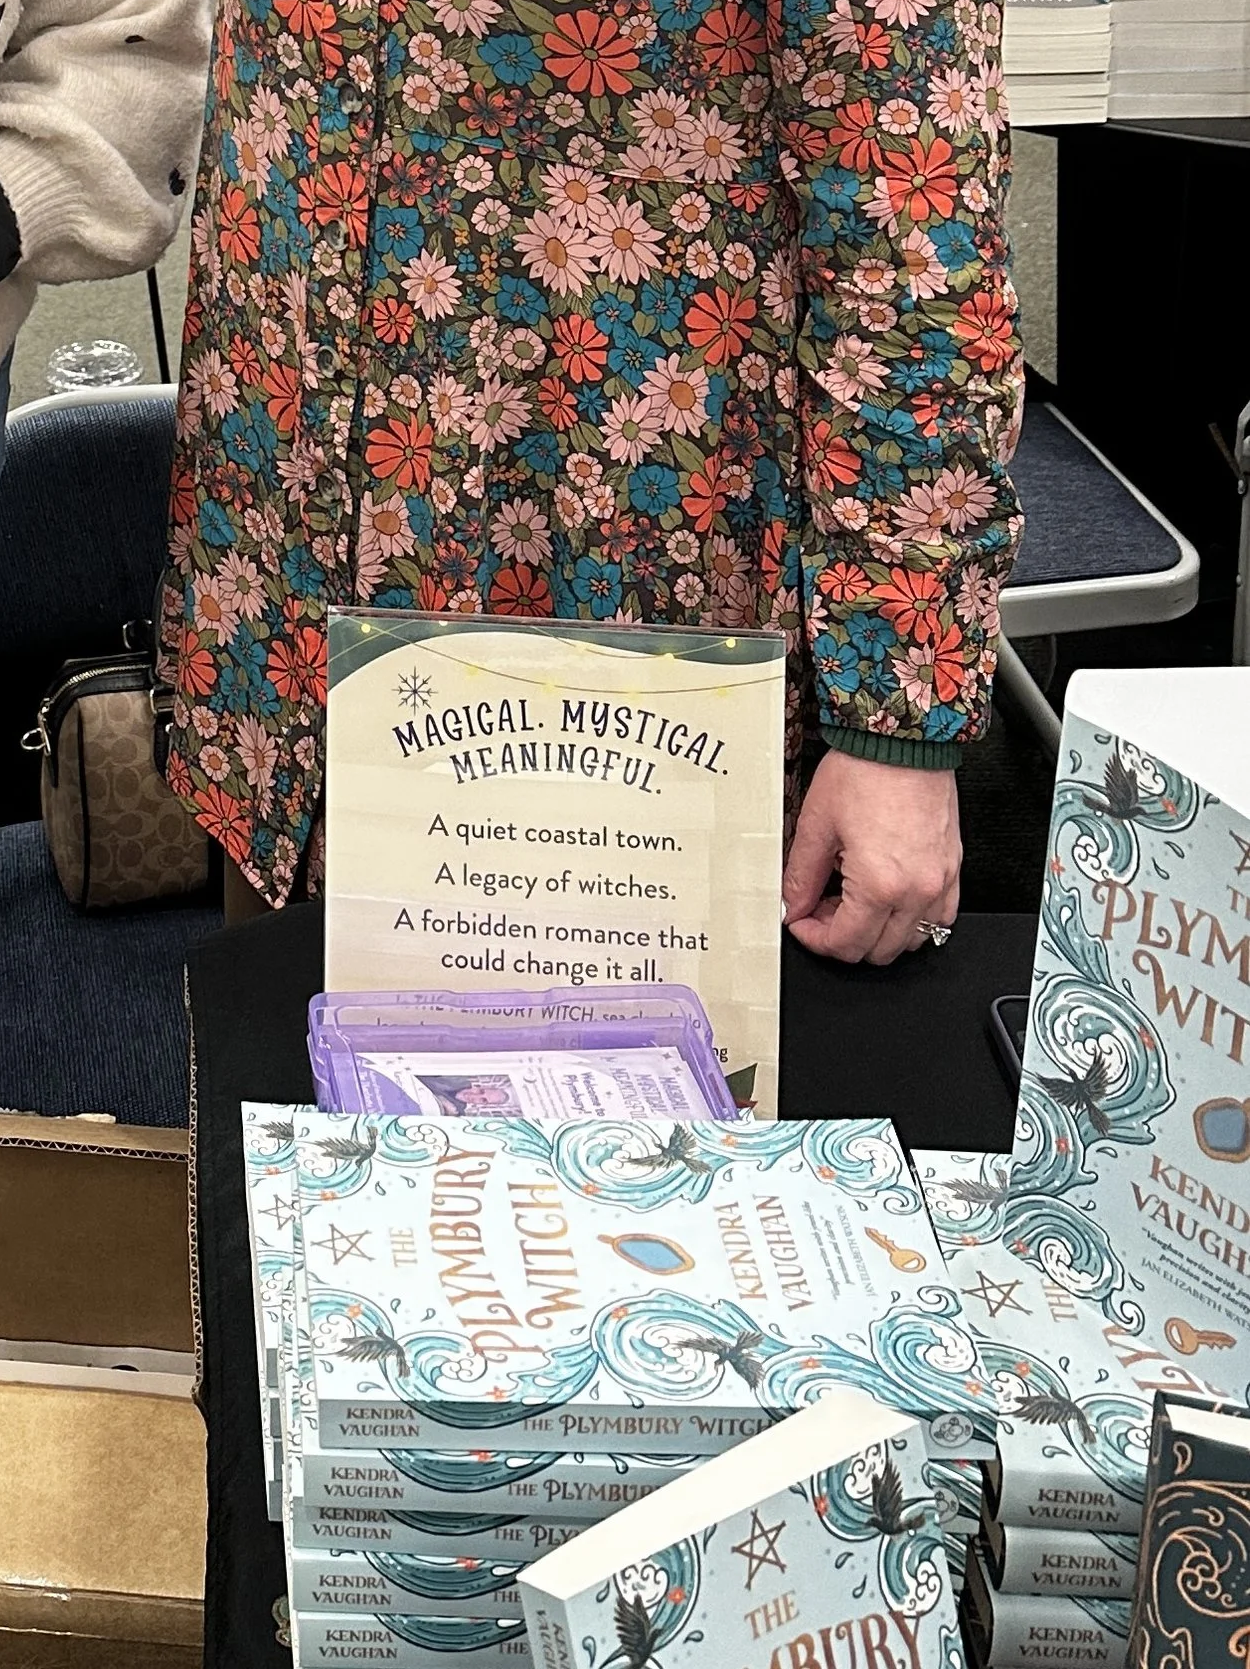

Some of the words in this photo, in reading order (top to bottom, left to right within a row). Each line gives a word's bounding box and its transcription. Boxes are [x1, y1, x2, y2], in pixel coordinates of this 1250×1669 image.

[391, 698, 545, 759] MAGICAL.
[560, 699, 730, 777] MYSTICAL.
[449, 741, 663, 795] MEANINGFUL.
[427, 814, 450, 837] A
[455, 819, 517, 847] quiet
[524, 825, 608, 848] coastal
[615, 829, 683, 853] town.
[434, 862, 456, 886] A
[463, 864, 539, 899] legacy
[545, 870, 572, 893] of
[578, 874, 677, 901] witches.
[393, 908, 415, 932] A
[421, 910, 537, 940] forbidden
[545, 924, 651, 947] romance
[657, 928, 710, 952] that
[440, 950, 505, 974] could
[513, 954, 599, 986] change
[605, 958, 623, 982] it
[629, 960, 664, 983] all.
[581, 1070, 600, 1106] Welcome
[835, 1204, 853, 1237] WATSON
[1130, 1180, 1250, 1279] VAUGH
[387, 1226, 419, 1269] THE
[429, 1145, 544, 1365] PLYMBURY
[507, 1180, 587, 1333] WITCH
[713, 1201, 768, 1302] KENDRA
[753, 1193, 816, 1313] VAUGHAN
[846, 1238, 871, 1281] ELIZABETH
[1141, 1256, 1162, 1277] JAN
[1162, 1270, 1223, 1313] ELIZABETH
[1159, 1253, 1201, 1283] precision
[1200, 1279, 1222, 1295] and
[1185, 1256, 1214, 1278] writes
[1215, 1272, 1237, 1292] with
[863, 1282, 877, 1297] JAN
[345, 1406, 415, 1421] KENDRA
[339, 1422, 420, 1438] VAUGHAN
[522, 1417, 554, 1432] THE
[559, 1413, 685, 1437] PLYMBURY
[330, 1465, 400, 1483] KENDRA
[323, 1483, 405, 1500] VAUGHAN
[507, 1482, 539, 1498] THE
[1037, 1487, 1117, 1508] KENDRA
[318, 1507, 387, 1523] KENDRA
[1027, 1505, 1121, 1524] VAUGHAN
[312, 1524, 393, 1541] VAUGHAN
[493, 1527, 525, 1543] THE
[1041, 1552, 1119, 1572] KENDRA
[318, 1573, 388, 1590] KENDRA
[1030, 1571, 1123, 1589] VAUGHAN
[311, 1590, 393, 1607] VAUGHAN
[493, 1590, 522, 1603] THE
[743, 1589, 801, 1640] THE
[325, 1628, 395, 1645] KENDRA
[1028, 1626, 1107, 1645] KENDRA
[318, 1644, 399, 1662] VAUGHAN
[498, 1641, 530, 1654] THE
[1018, 1643, 1110, 1663] VAUGHAN
